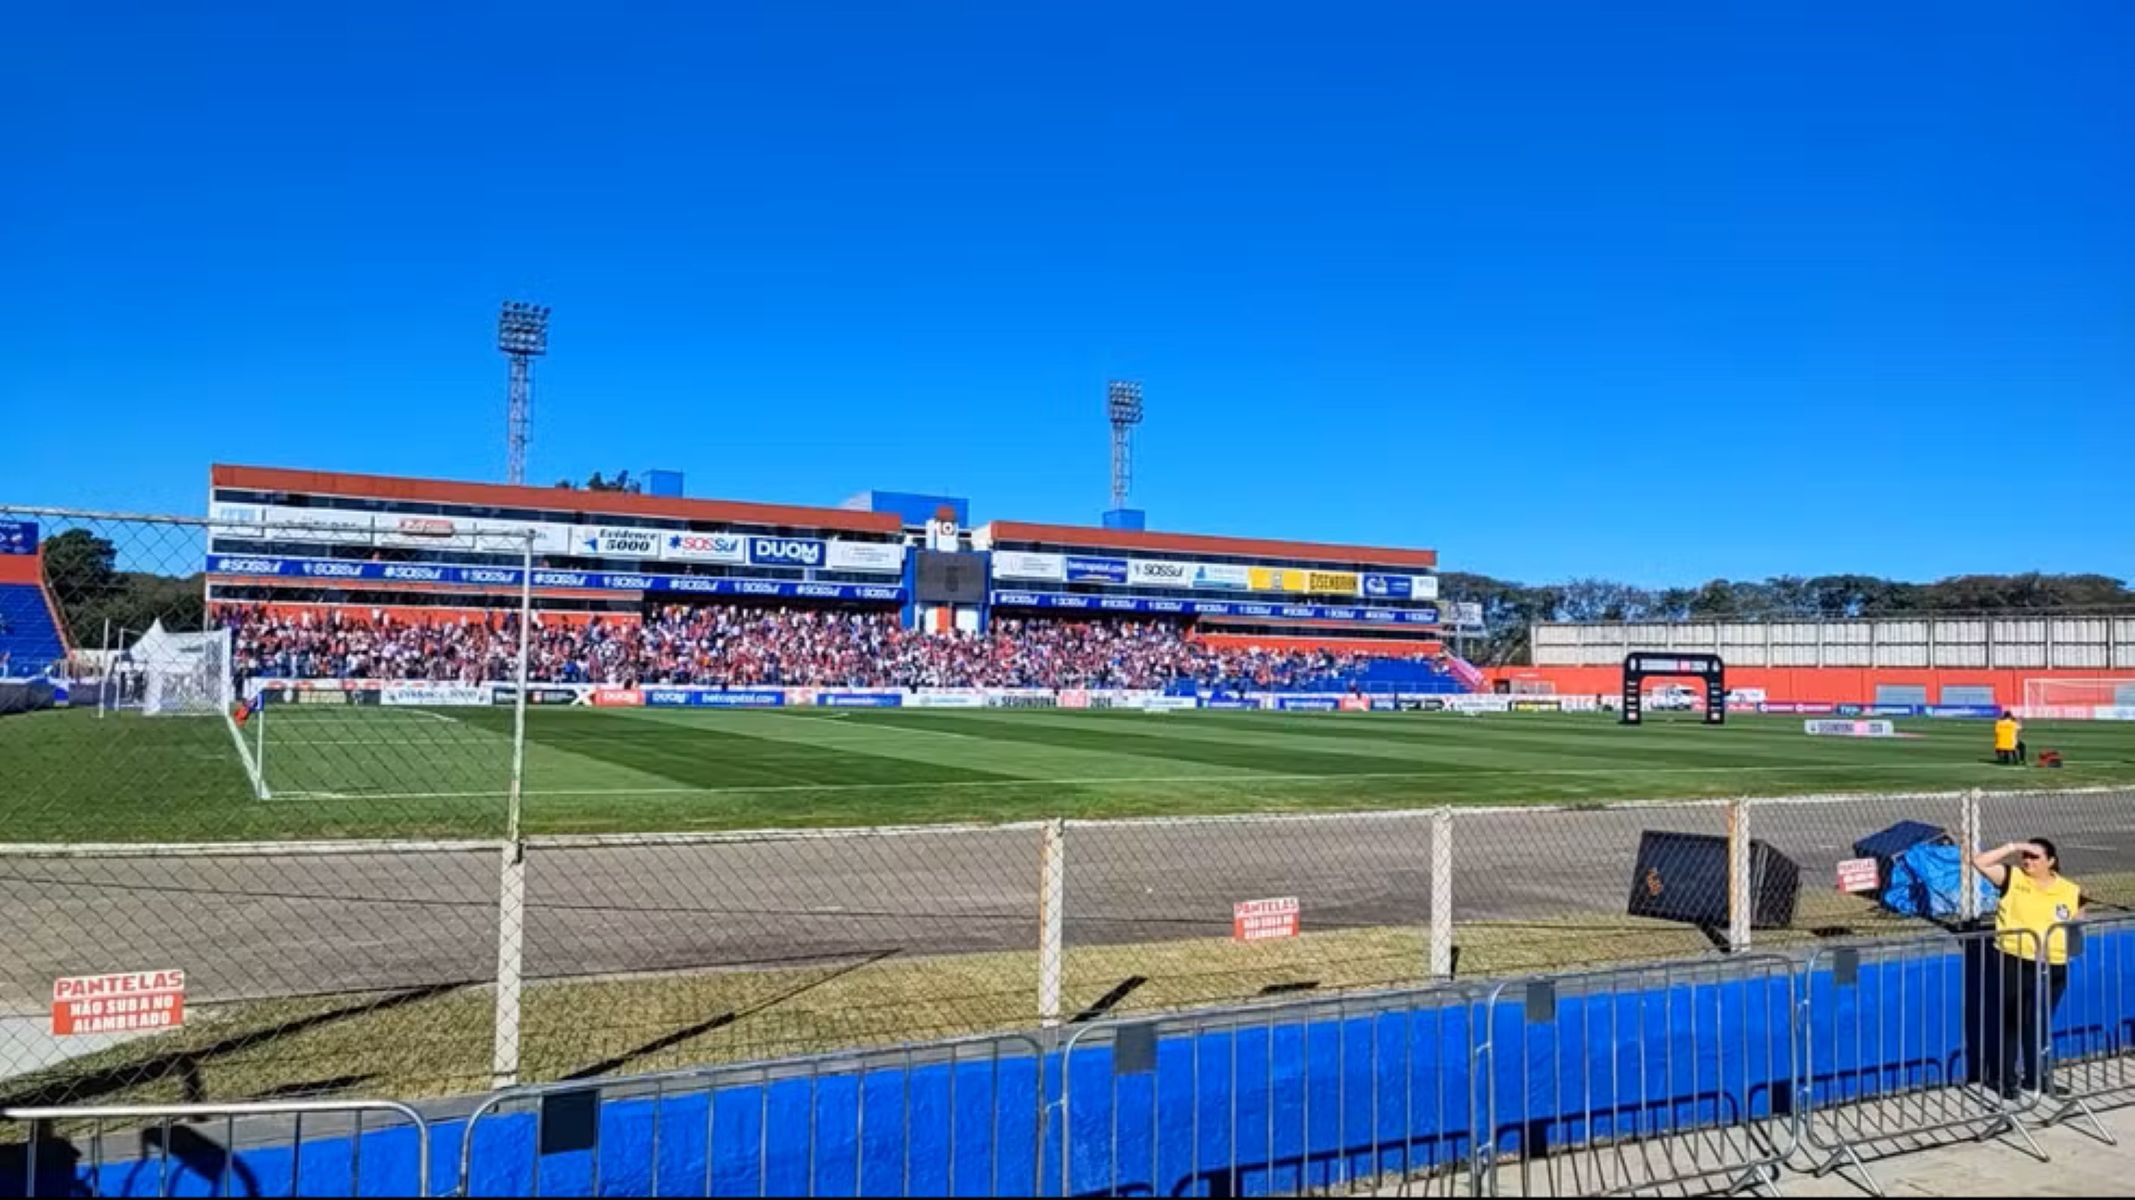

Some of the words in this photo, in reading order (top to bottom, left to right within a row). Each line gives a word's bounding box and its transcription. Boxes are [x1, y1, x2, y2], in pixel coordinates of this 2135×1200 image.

[600, 528, 657, 541] Evidence
[606, 539, 651, 552] 5000
[56, 971, 183, 996] PANTELAS
[153, 995, 174, 1010] NO
